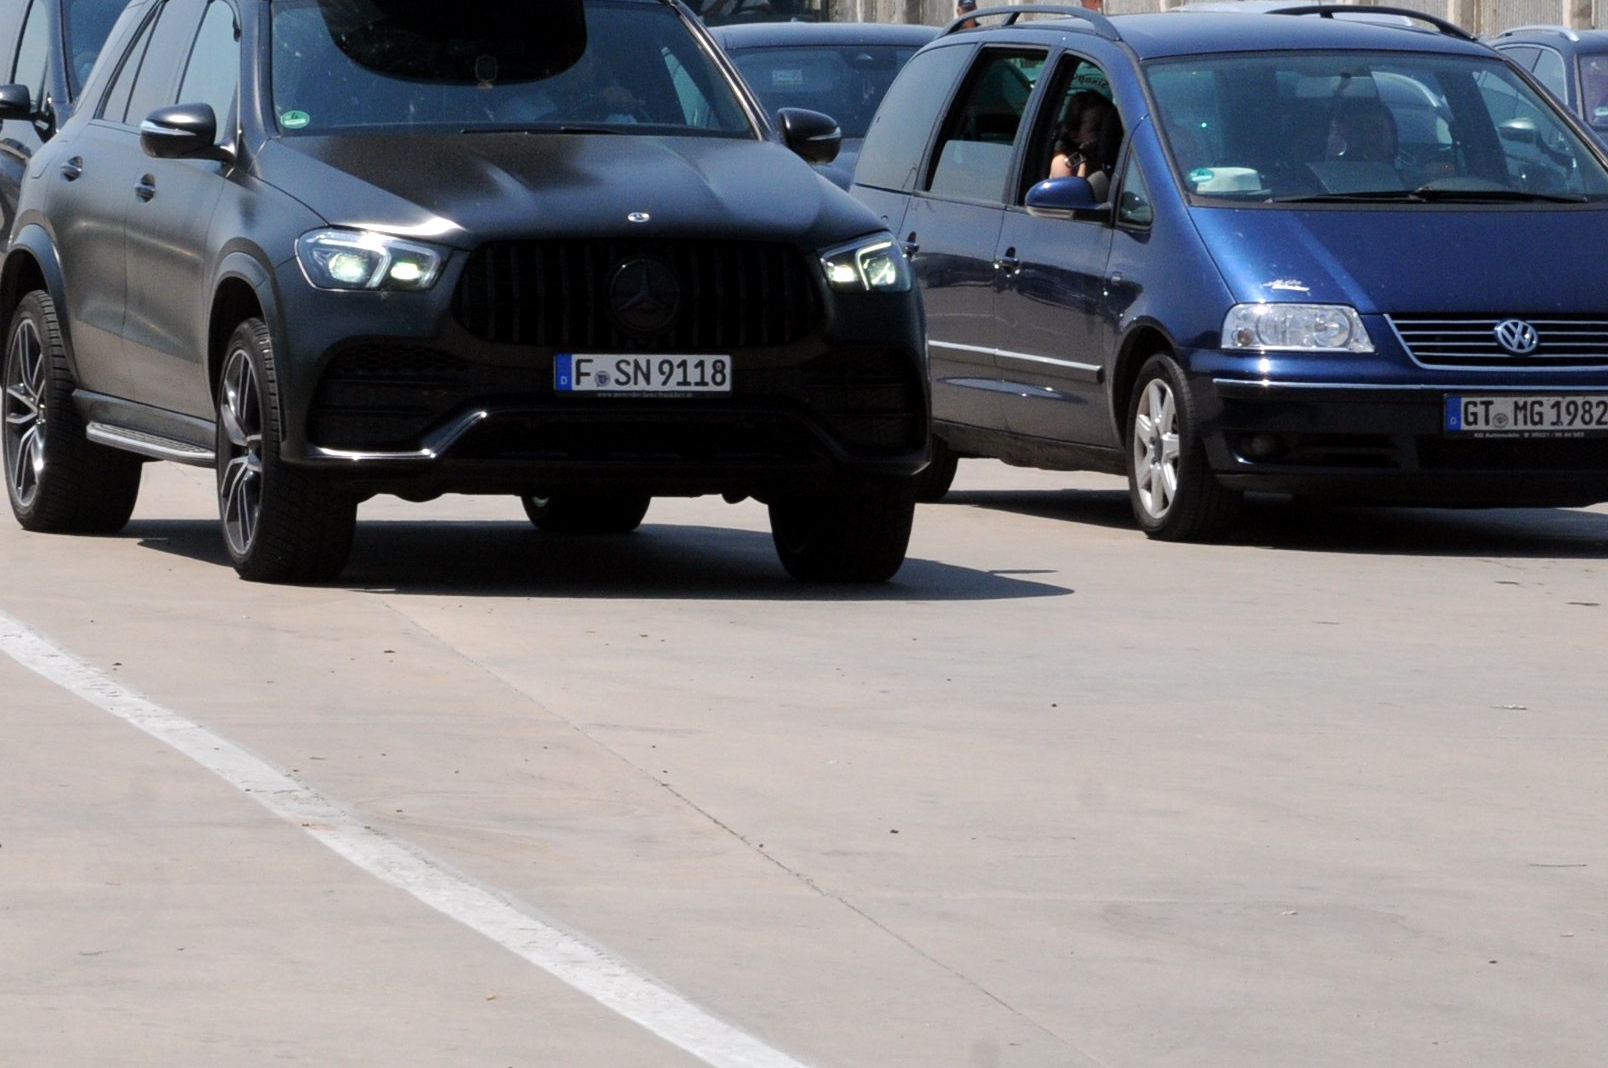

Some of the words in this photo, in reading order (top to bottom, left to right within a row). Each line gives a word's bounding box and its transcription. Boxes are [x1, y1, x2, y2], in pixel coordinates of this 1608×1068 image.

[575, 358, 594, 386] F
[614, 358, 651, 386] SN
[658, 358, 727, 387] 9118
[1463, 400, 1495, 426] GT
[1513, 400, 1544, 426] MG
[1550, 400, 1608, 426] 1982
